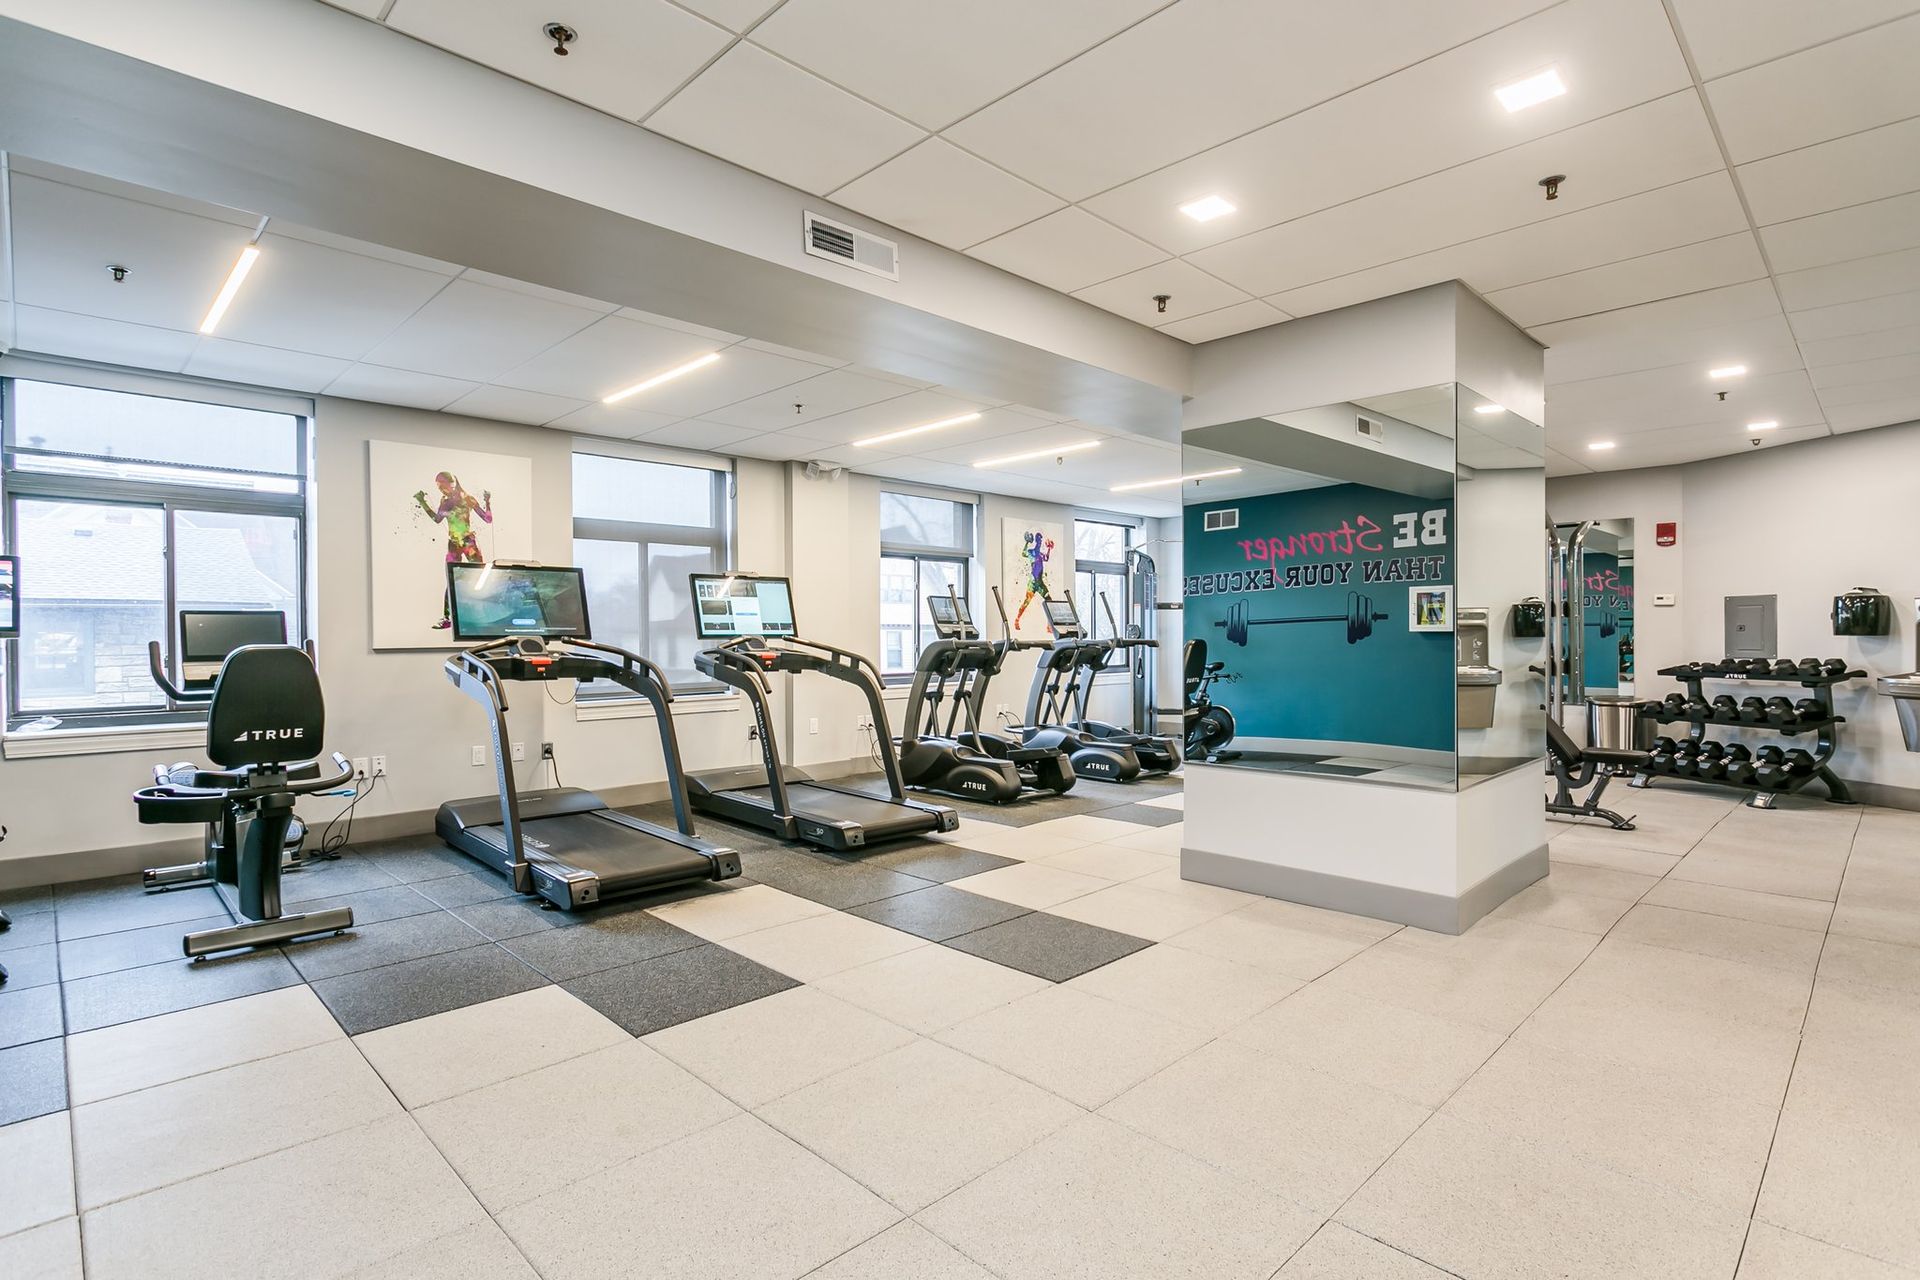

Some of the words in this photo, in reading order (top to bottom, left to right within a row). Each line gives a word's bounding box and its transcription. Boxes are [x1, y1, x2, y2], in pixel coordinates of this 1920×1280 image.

[251, 728, 304, 741] TRUE
[1090, 762, 1110, 771] TRUE
[967, 781, 987, 791] TRUE
